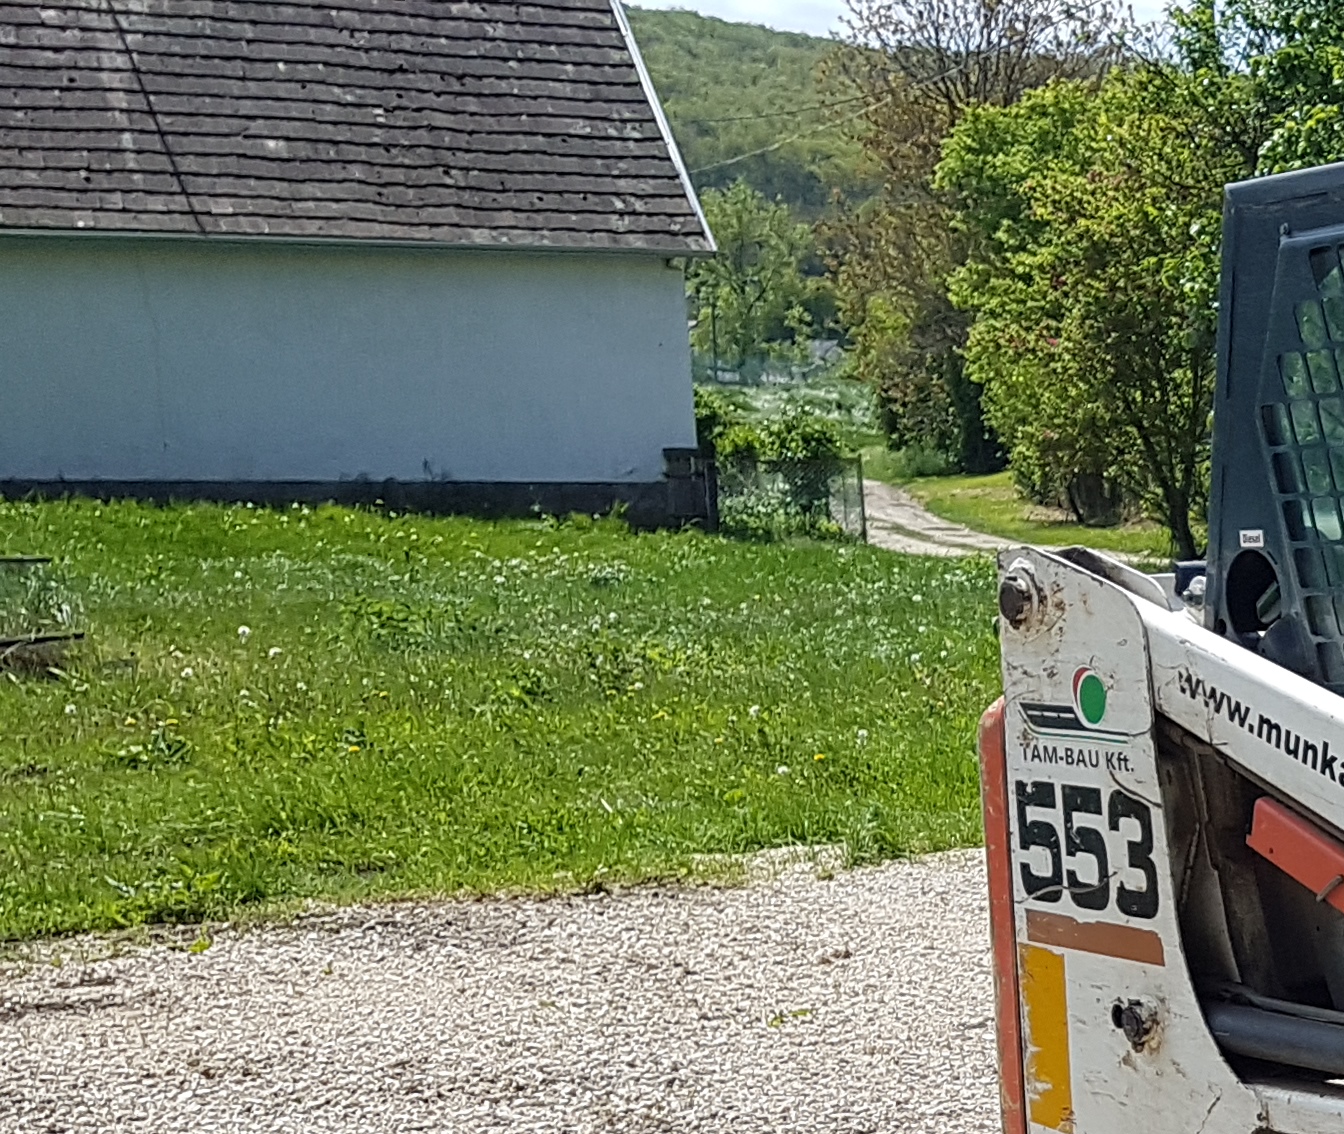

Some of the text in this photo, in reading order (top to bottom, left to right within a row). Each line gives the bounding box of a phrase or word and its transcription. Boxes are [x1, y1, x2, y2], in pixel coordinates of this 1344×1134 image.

[1019, 744, 1134, 773] TAM-BAU Kft.
[1017, 780, 1158, 918] 553
